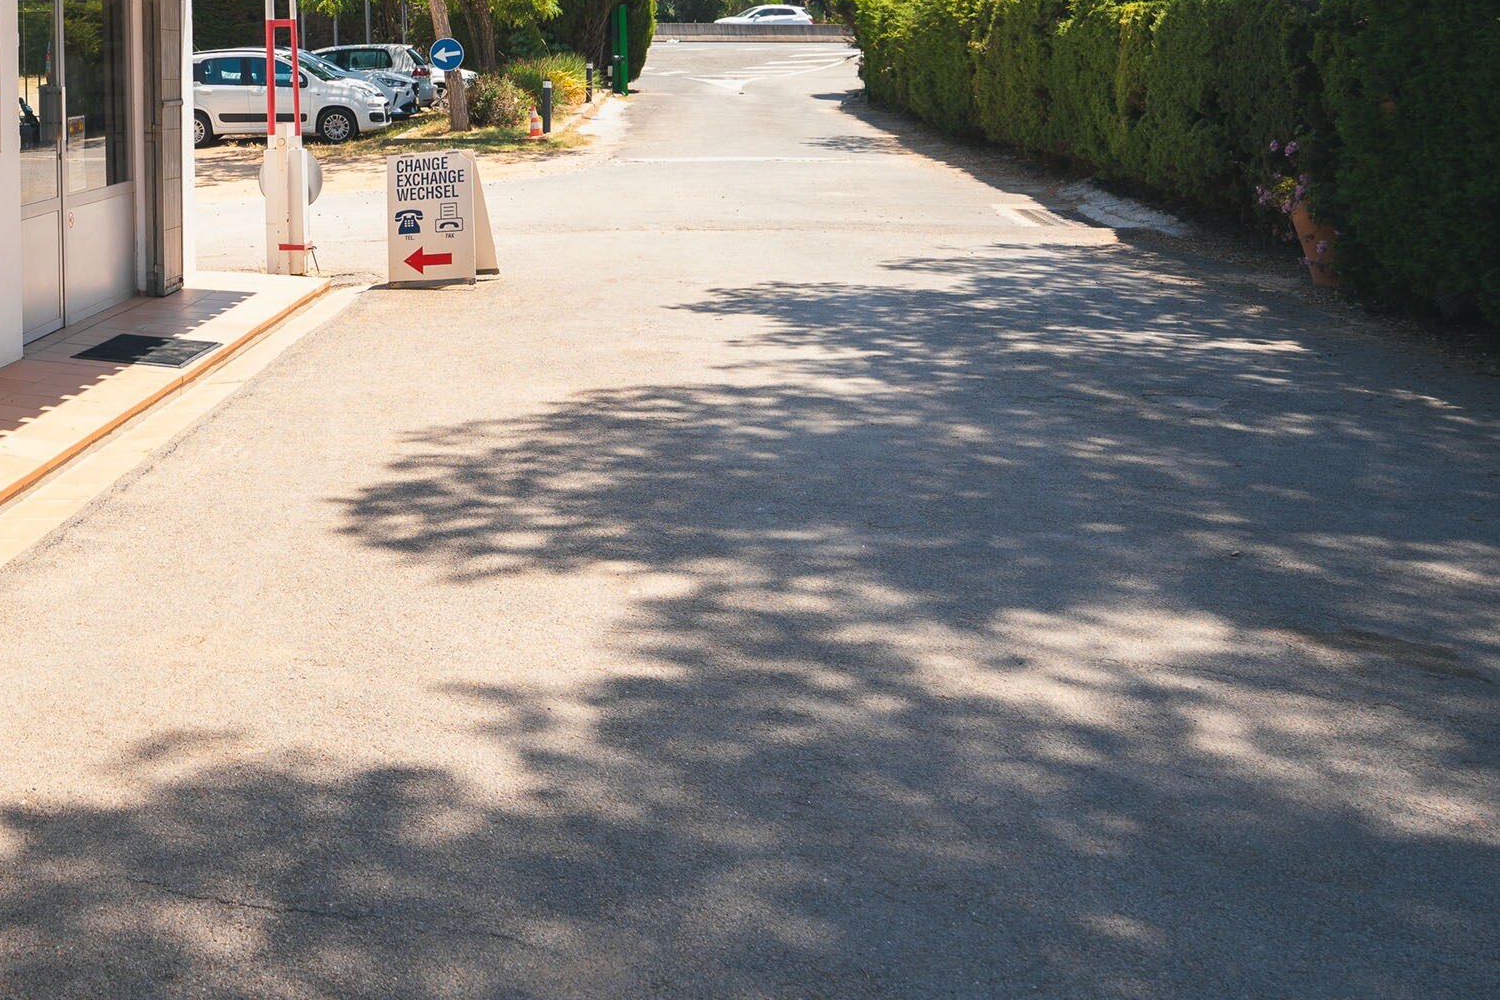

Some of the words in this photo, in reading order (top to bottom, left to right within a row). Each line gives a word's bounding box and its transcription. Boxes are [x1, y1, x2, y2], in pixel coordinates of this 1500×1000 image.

[396, 156, 448, 173] CHANGE
[396, 169, 465, 187] EXCHANGE
[396, 184, 459, 201] WECHSEL
